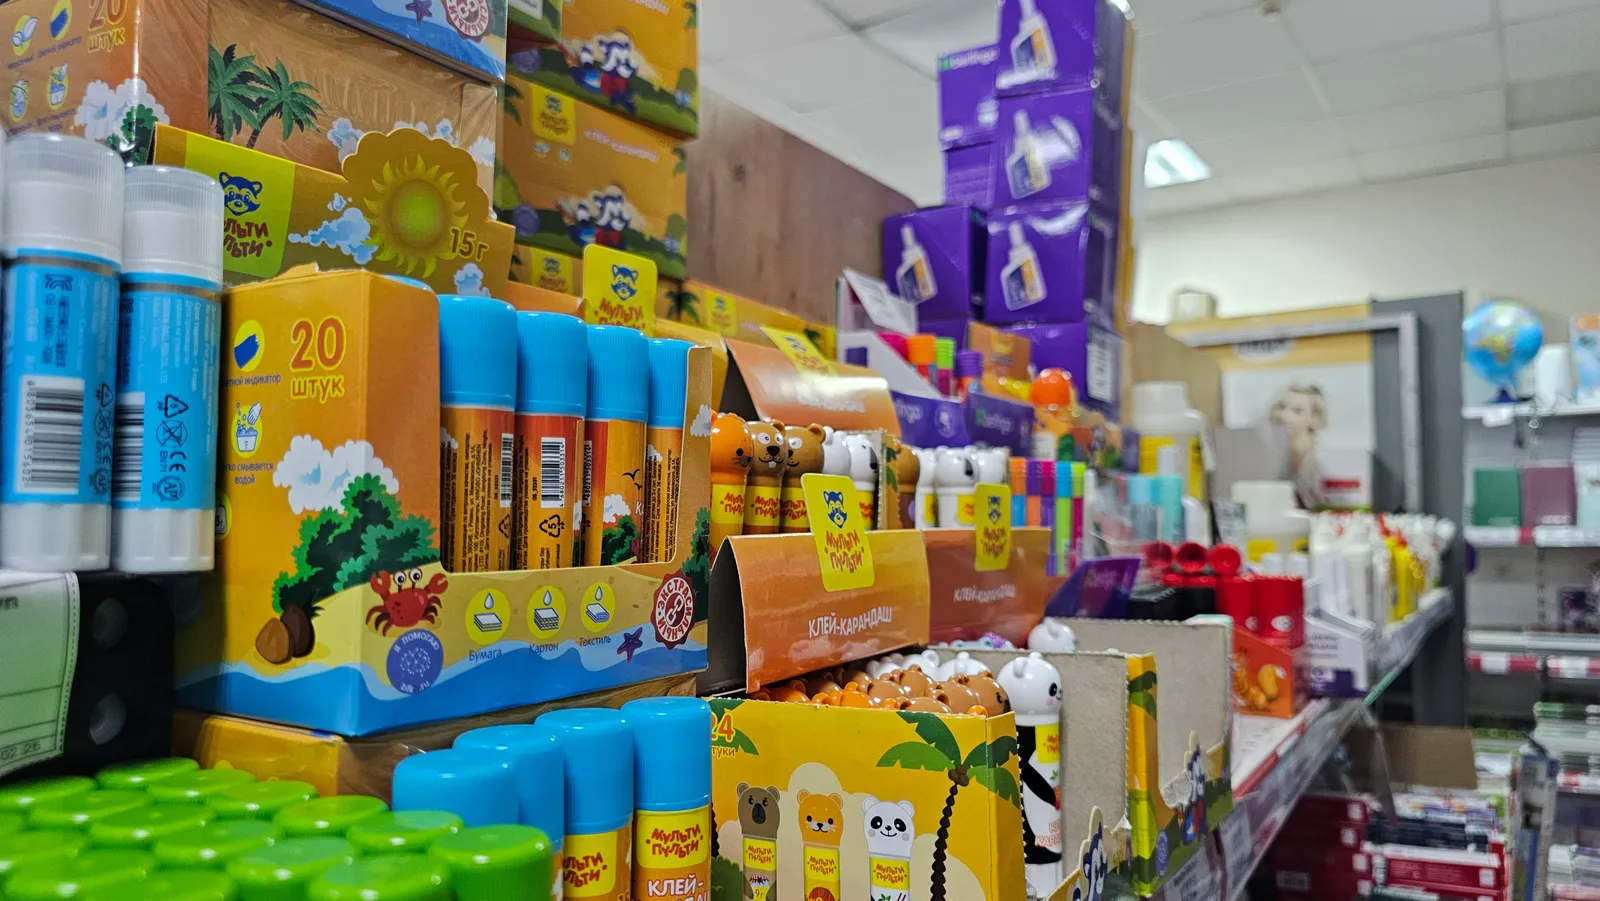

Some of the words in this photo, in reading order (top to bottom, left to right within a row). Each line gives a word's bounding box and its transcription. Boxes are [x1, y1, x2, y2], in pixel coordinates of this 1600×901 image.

[88, 0, 126, 31] 20
[223, 217, 269, 239] ЛЬТИ
[223, 234, 264, 258] ЛЬТИ
[290, 315, 346, 372] 20
[244, 374, 282, 386] индикатор
[159, 450, 168, 472] EN71
[237, 462, 274, 472] смывается
[234, 474, 256, 486] водой
[724, 492, 744, 507] МУЛ
[755, 495, 779, 509] МУЛЬ
[724, 503, 744, 517] ПУЛ
[755, 506, 778, 519] ПУЛЬ
[826, 529, 860, 553] МУЛЬТИ
[829, 550, 864, 574] ПУЛЬТИ
[808, 605, 893, 639] КЛЕЙ-КАРАНДАШ
[401, 631, 440, 651] ПОМОГАЮ
[468, 647, 502, 662] Бумага
[528, 641, 559, 656] Картон
[578, 635, 611, 647] Текстиль
[711, 746, 735, 759] туки
[651, 824, 701, 845] МУЛЬТИ
[652, 840, 699, 858] ПУЛЬТИ
[563, 852, 603, 872] ЛЬТИ
[809, 855, 835, 867] МУЛЬТИ
[876, 863, 905, 876] МУЛЬТИ
[563, 869, 601, 888] ЛЬТИ
[648, 874, 705, 897] КЛЕЙ-
